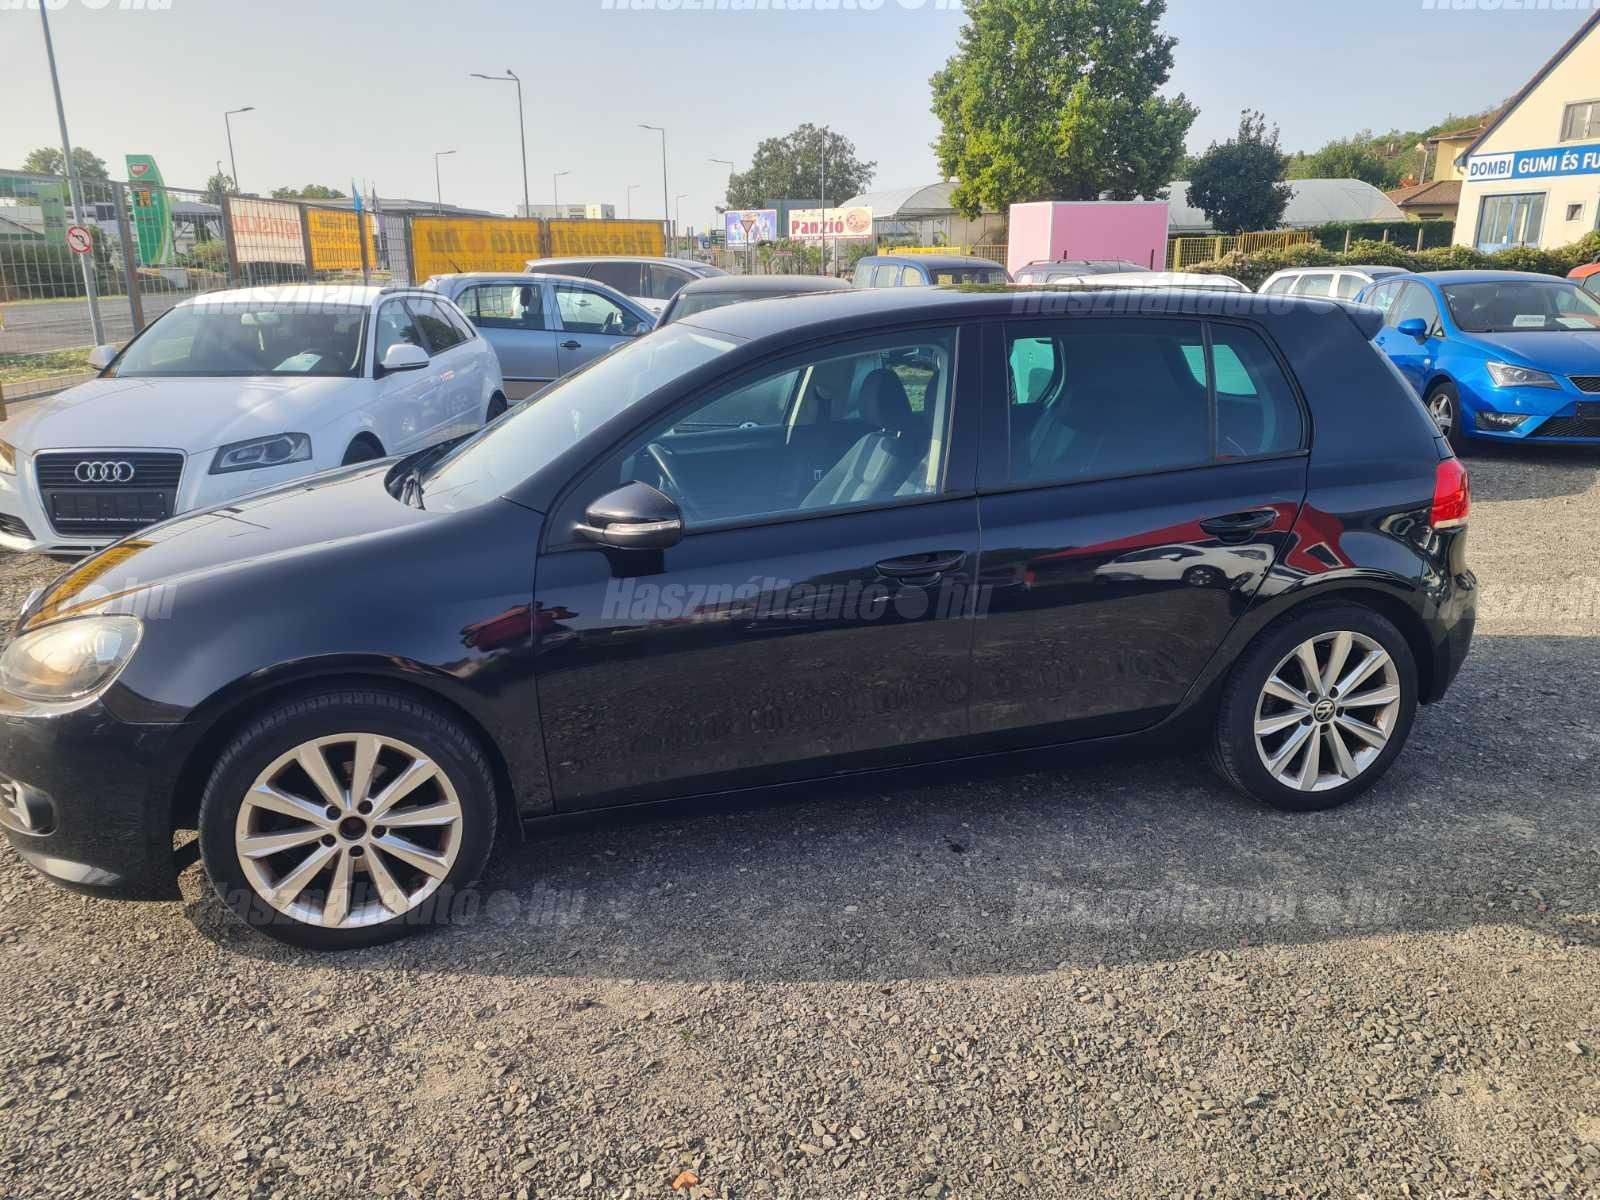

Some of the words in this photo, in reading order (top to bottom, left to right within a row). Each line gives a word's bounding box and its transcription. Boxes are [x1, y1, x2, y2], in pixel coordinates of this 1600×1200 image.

[1471, 160, 1511, 176] DOMBI
[1518, 157, 1557, 173] GUMI
[1561, 151, 1578, 171] ÉS
[791, 216, 844, 235] Panzió
